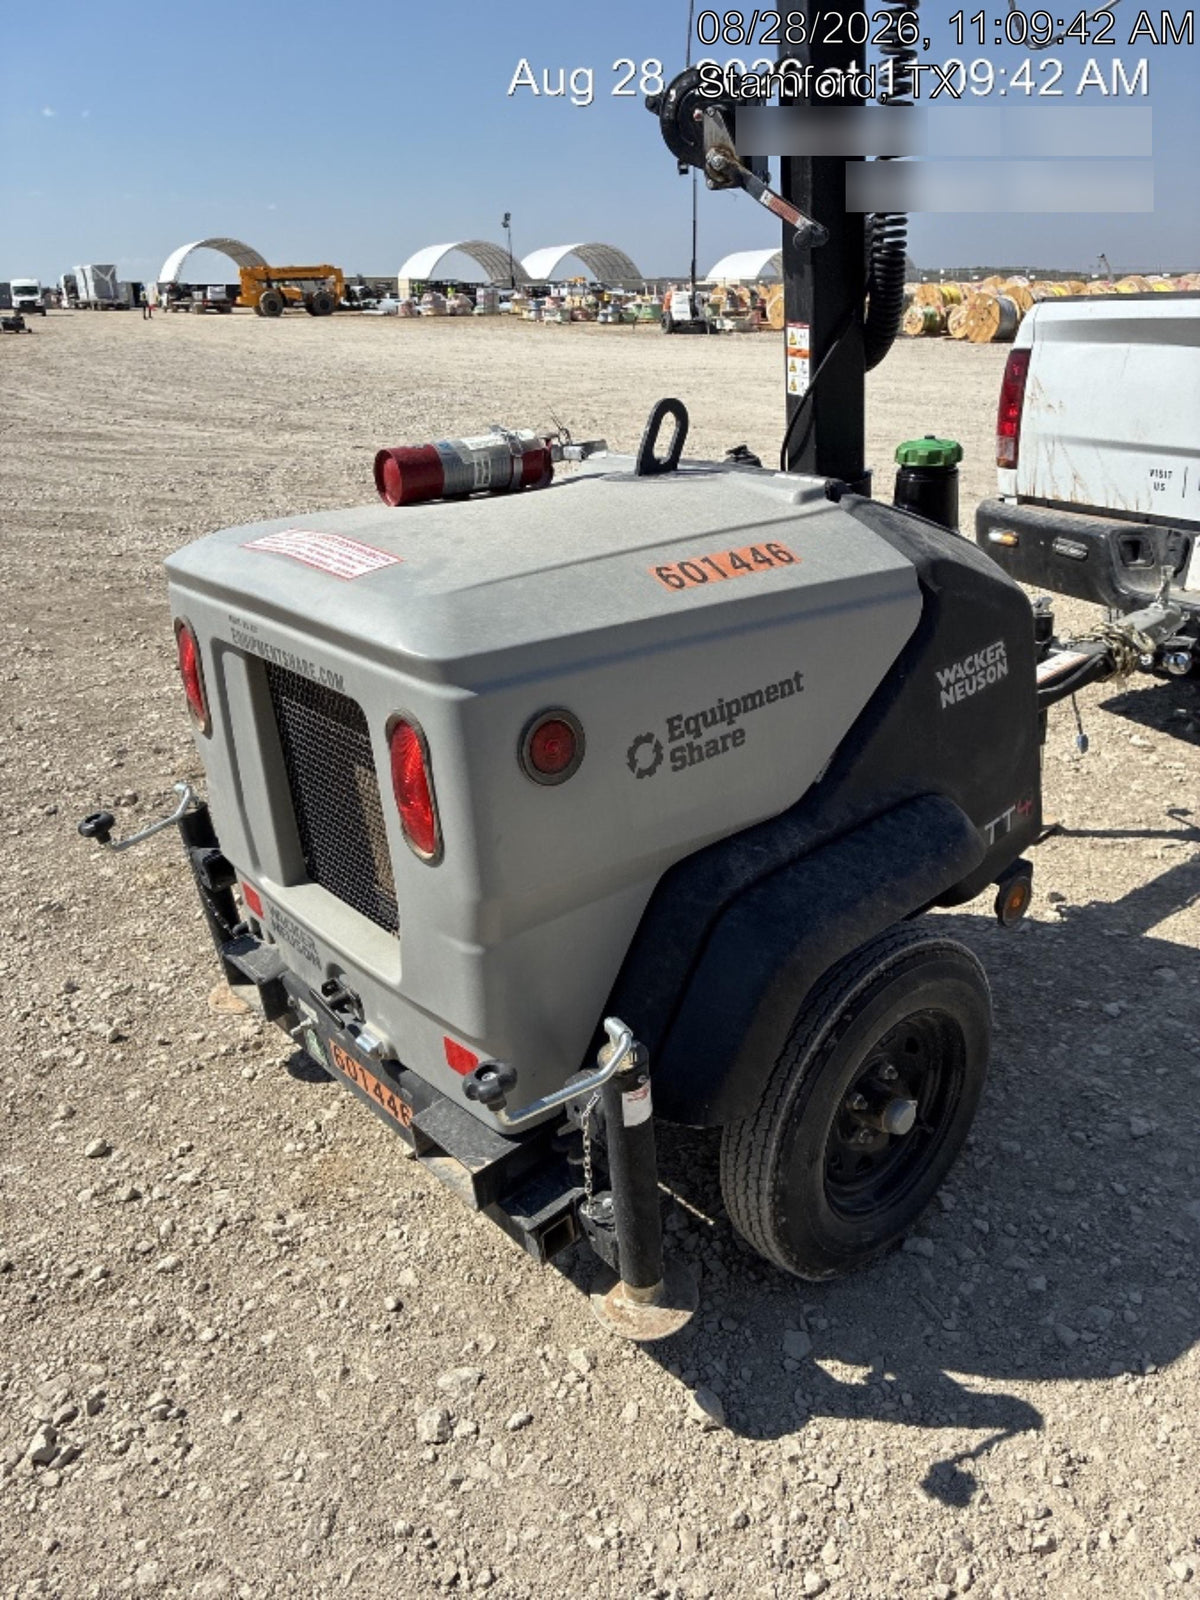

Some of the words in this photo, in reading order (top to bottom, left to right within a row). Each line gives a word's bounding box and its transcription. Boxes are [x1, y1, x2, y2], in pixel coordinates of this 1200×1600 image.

[1149, 469, 1172, 479] VISIT
[1153, 481, 1166, 491] US
[655, 543, 796, 590] 601446
[936, 640, 1007, 688] WACKER
[940, 657, 1008, 709] NEUSON
[666, 670, 804, 743] Equipment
[670, 727, 746, 772] Share
[334, 1045, 411, 1129] 601446
